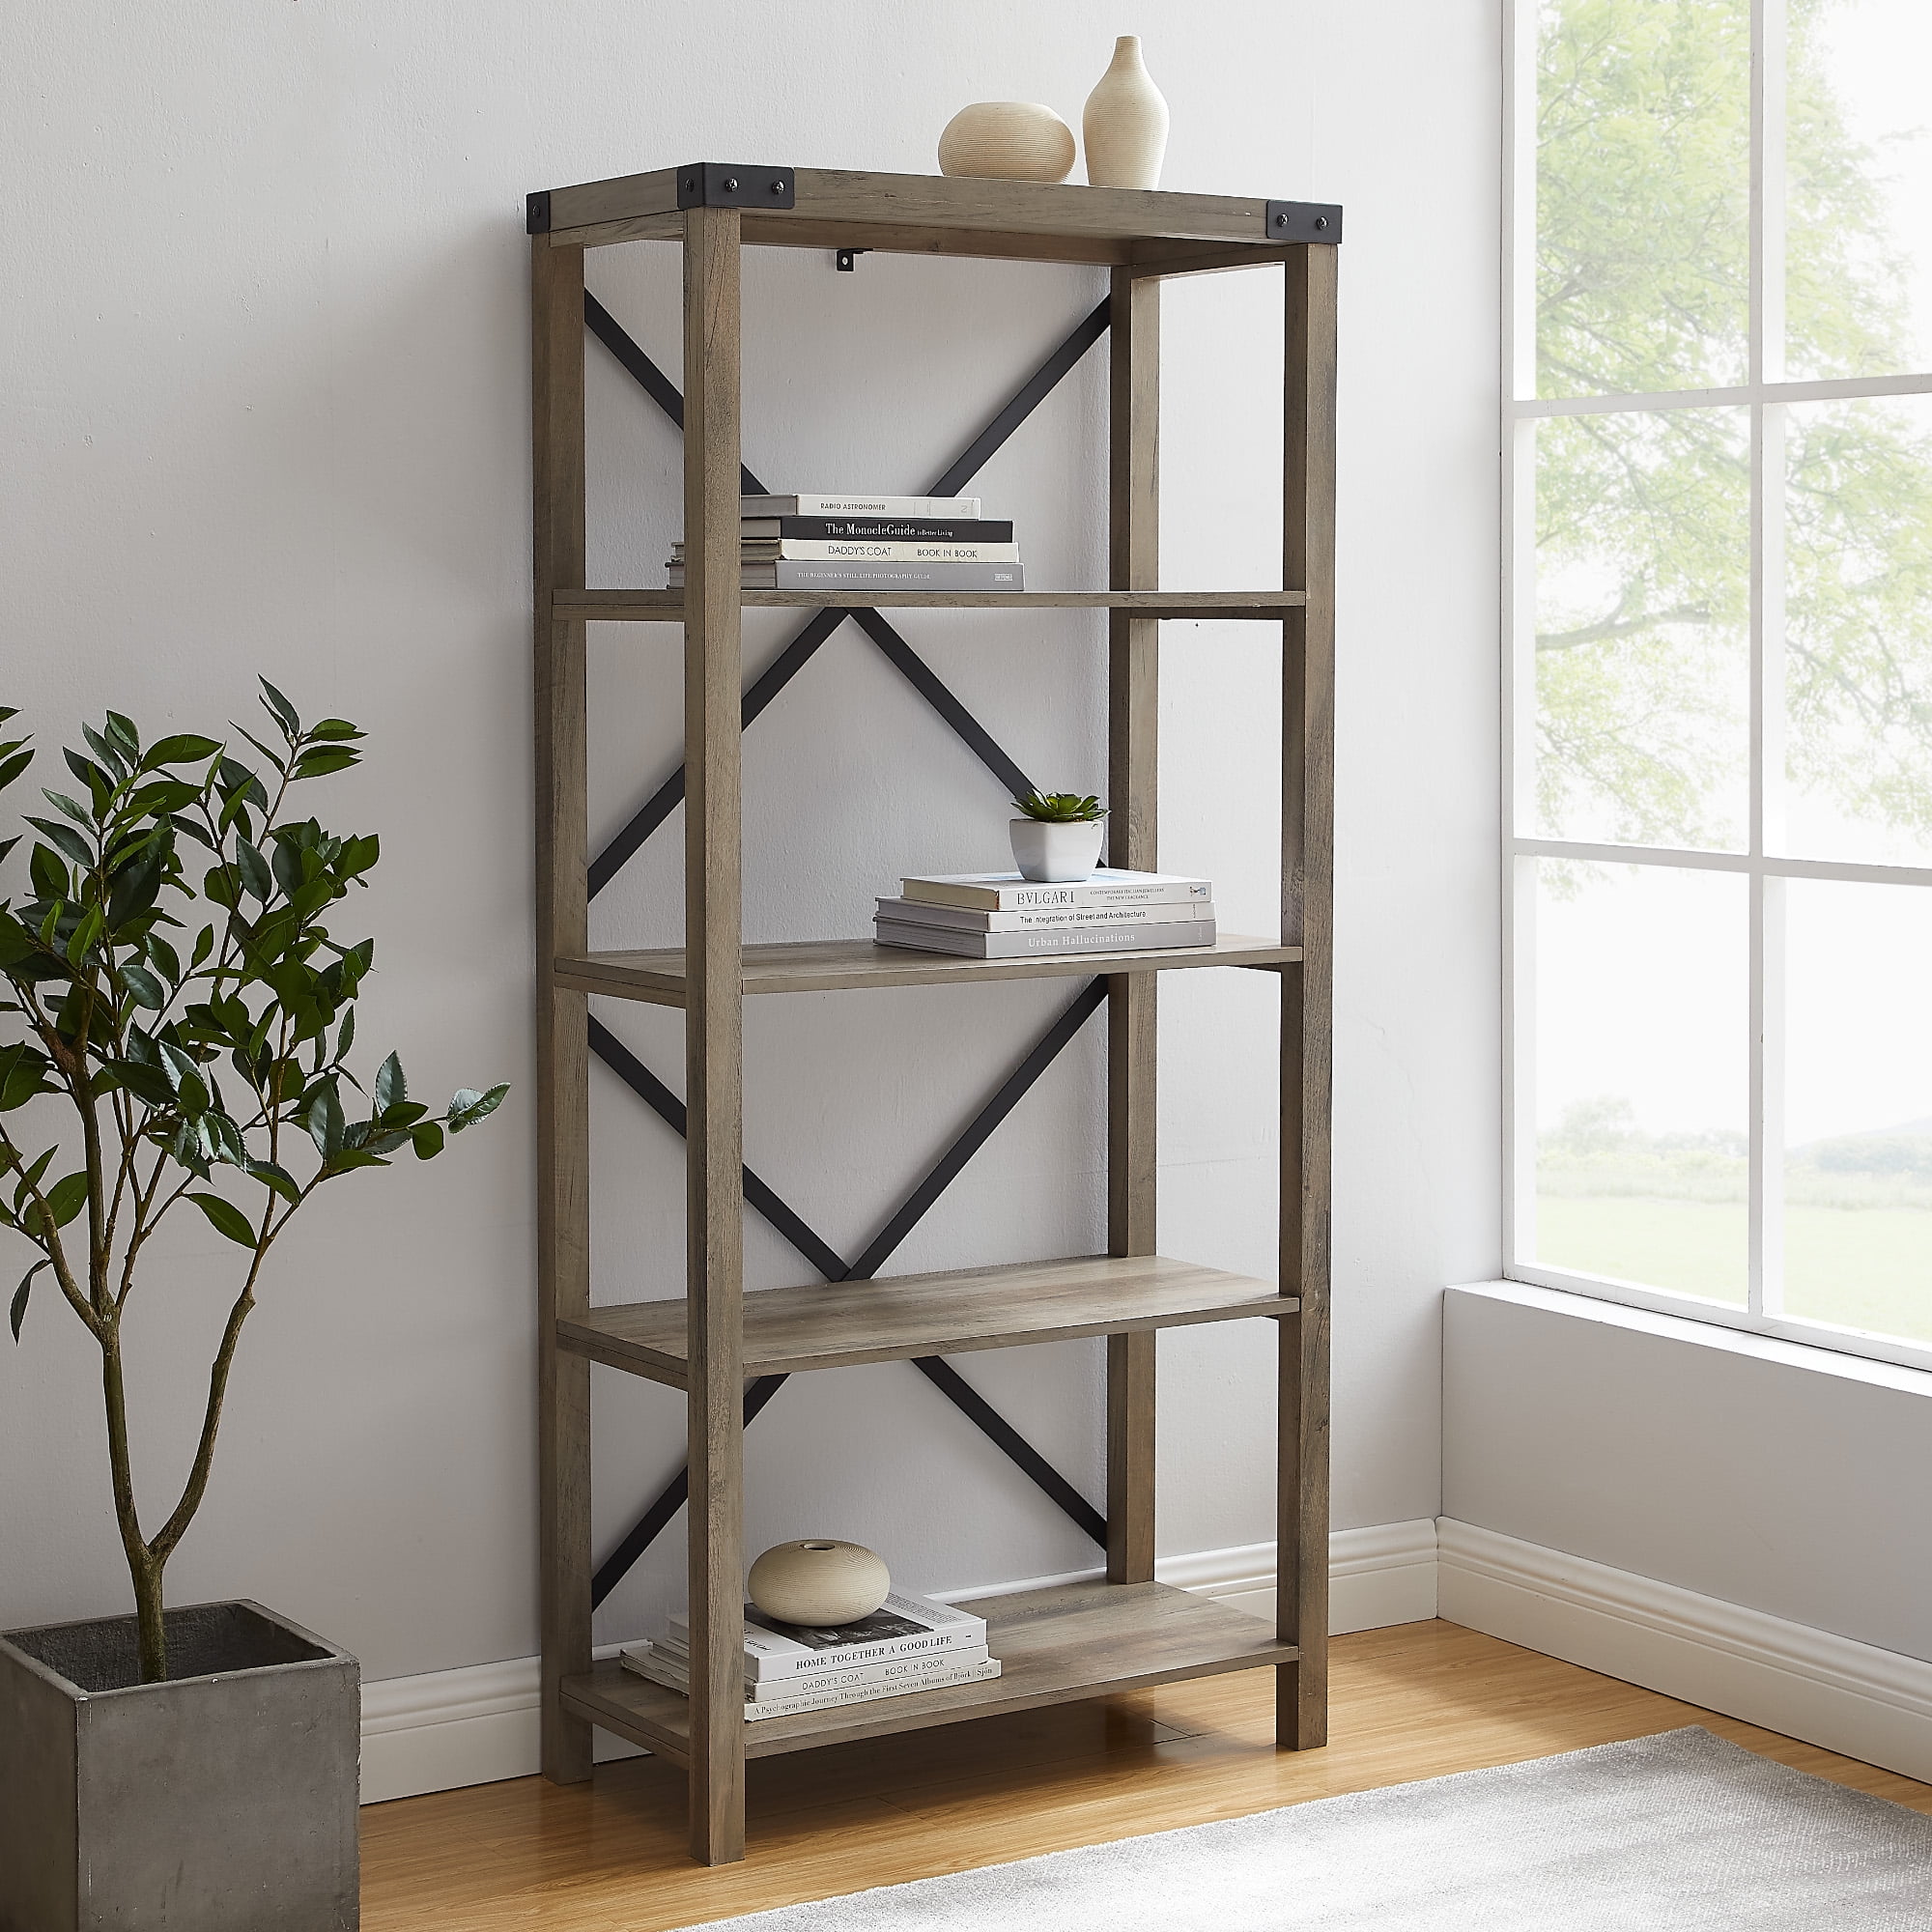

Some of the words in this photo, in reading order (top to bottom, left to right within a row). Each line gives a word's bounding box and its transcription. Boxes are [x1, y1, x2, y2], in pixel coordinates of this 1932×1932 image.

[825, 523, 844, 535] The
[828, 545, 865, 555] DADDY'S
[867, 547, 892, 556] COAT
[917, 549, 941, 557] BOOK
[954, 550, 978, 558] BOOK
[1016, 891, 1075, 905] BVLGARI
[1034, 915, 1067, 924] Integration
[1068, 913, 1074, 922] of
[1075, 913, 1095, 922] Street
[1108, 911, 1147, 920] Architecture
[1028, 937, 1059, 948] Urban
[1063, 932, 1135, 946] Hallucinations
[796, 1657, 827, 1670] HOME
[831, 1647, 885, 1664] TOGETHER
[888, 1645, 895, 1655] A
[899, 1640, 928, 1653] GOOD
[930, 1635, 952, 1647] LIFE
[885, 1665, 908, 1676] BOOK
[910, 1662, 919, 1671] IN
[922, 1660, 945, 1670] BOOK
[802, 1677, 838, 1690] DADDY'S
[840, 1672, 864, 1684] COAT
[753, 1707, 760, 1716] A
[761, 1699, 810, 1715] Psychographic
[811, 1695, 838, 1706] Journey
[839, 1689, 868, 1700] Through
[869, 1686, 880, 1695] the
[882, 1685, 897, 1693] First
[898, 1681, 919, 1690] Seven
[921, 1676, 945, 1687] Albums
[946, 1673, 953, 1682] of
